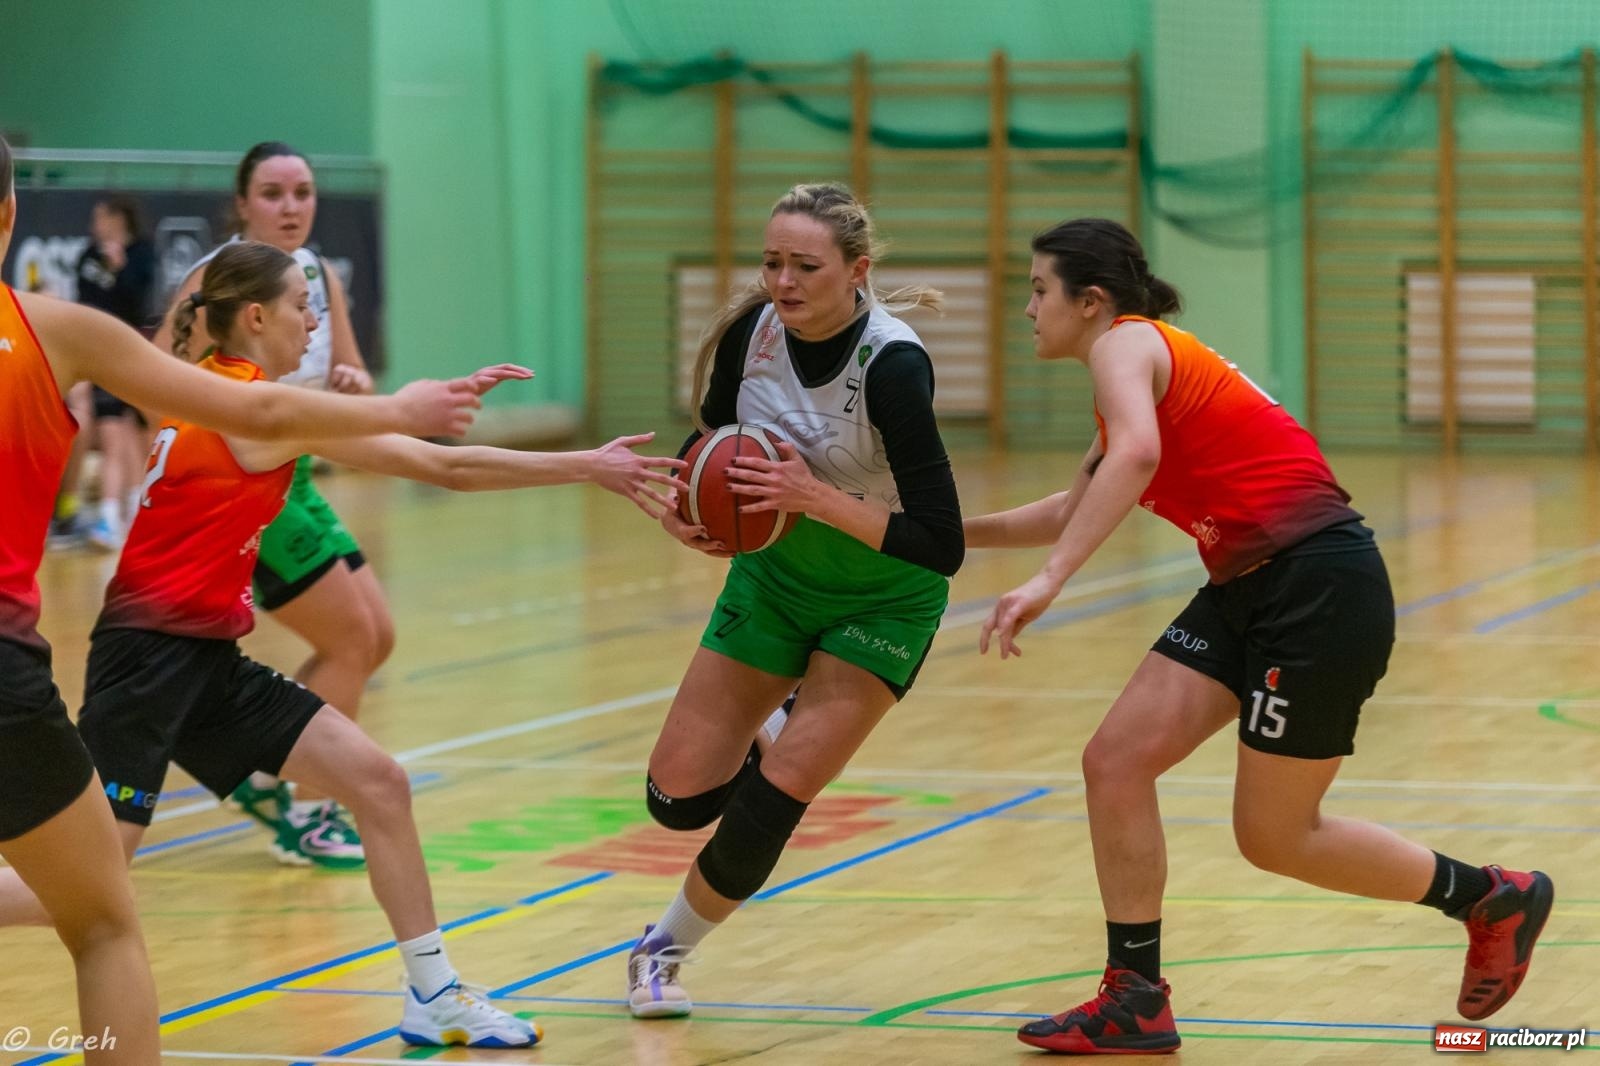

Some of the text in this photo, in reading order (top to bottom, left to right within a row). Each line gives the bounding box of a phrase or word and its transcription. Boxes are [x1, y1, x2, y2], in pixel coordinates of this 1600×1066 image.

[843, 377, 861, 414] 7
[713, 602, 752, 640] 7
[1248, 690, 1290, 739] 15
